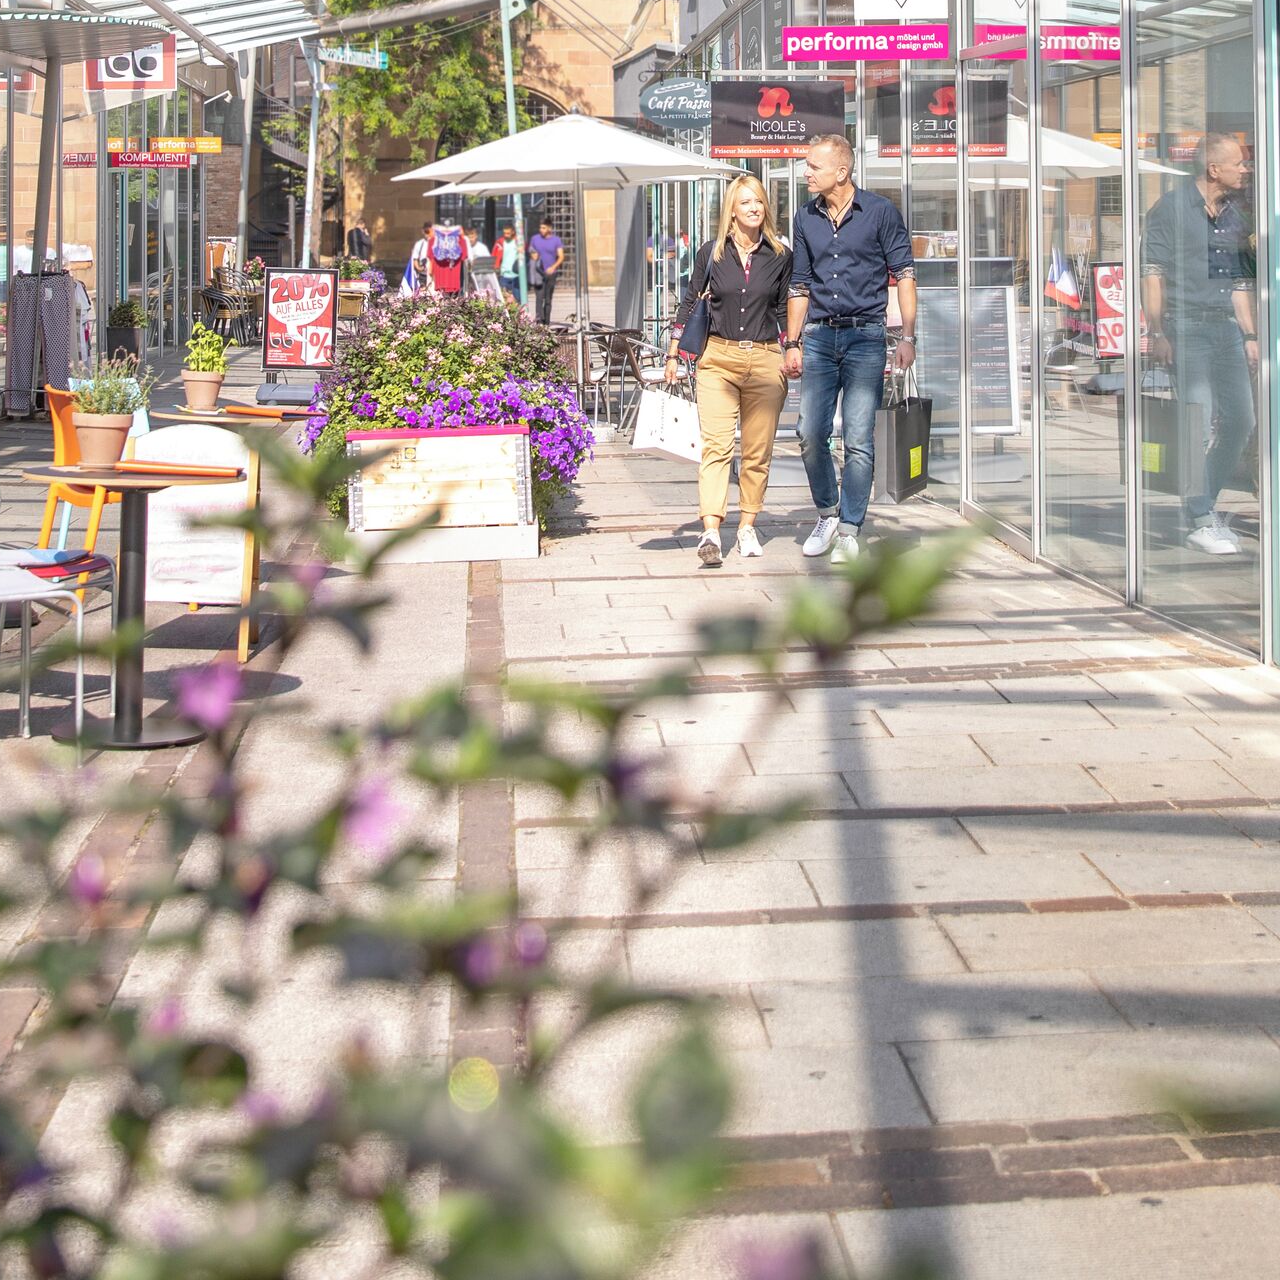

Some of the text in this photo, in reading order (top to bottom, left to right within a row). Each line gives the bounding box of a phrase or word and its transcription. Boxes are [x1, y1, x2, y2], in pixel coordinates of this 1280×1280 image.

[921, 33, 935, 41] und
[896, 41, 944, 51] design gmbh
[648, 95, 711, 113] Café Passa
[118, 152, 188, 163] KOMPLIMENT!
[270, 273, 330, 304] 20%
[276, 299, 324, 315] AUF ALLES
